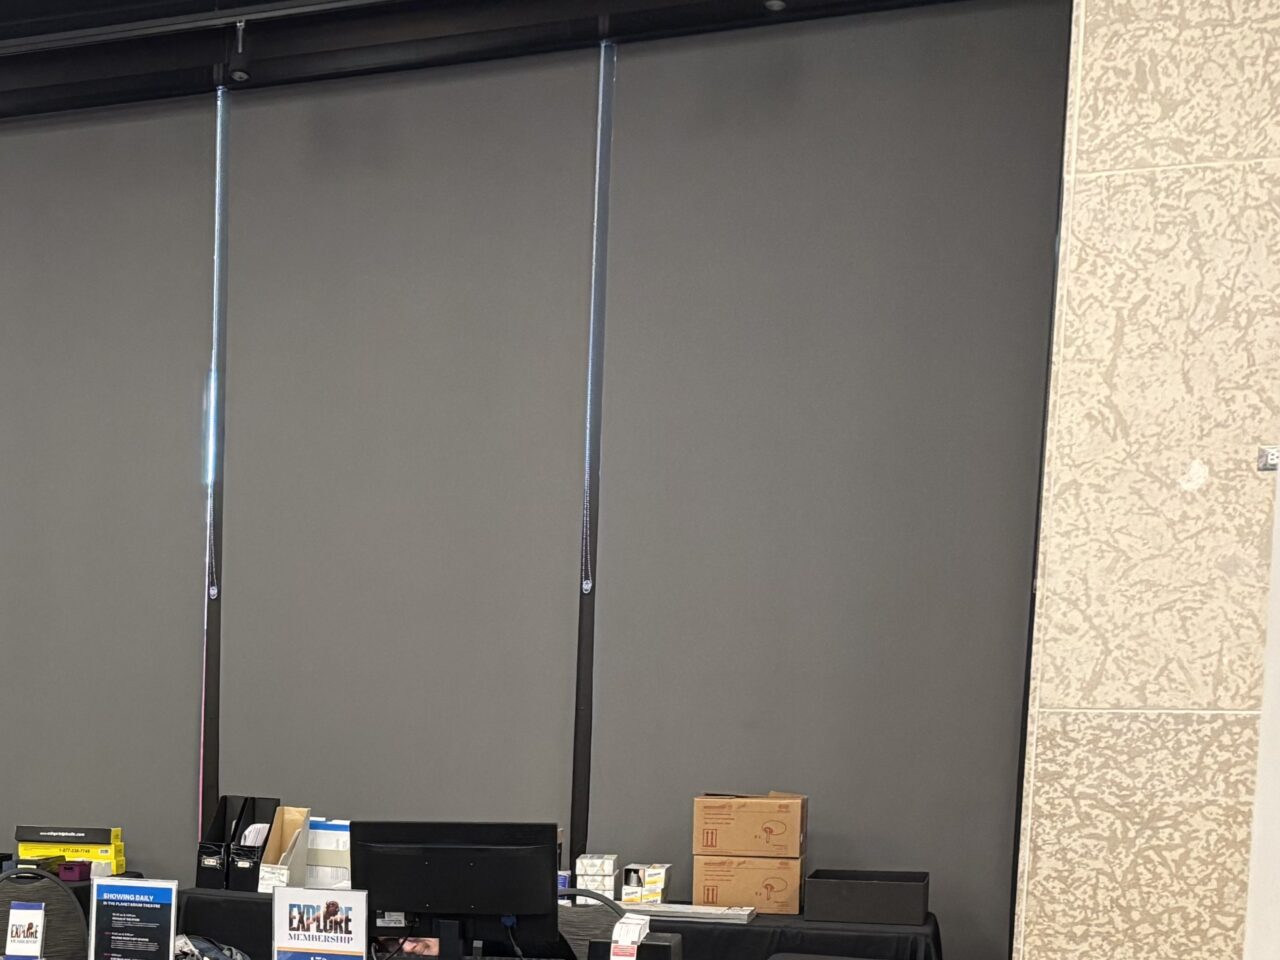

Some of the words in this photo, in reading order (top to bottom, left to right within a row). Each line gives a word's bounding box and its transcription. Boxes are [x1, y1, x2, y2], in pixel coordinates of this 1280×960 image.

[103, 892, 135, 901] SHOWING
[135, 894, 154, 902] DAILY
[288, 903, 353, 935] EXPLORE
[10, 923, 39, 939] EXPLORE
[287, 932, 354, 945] MEMBERSHIP
